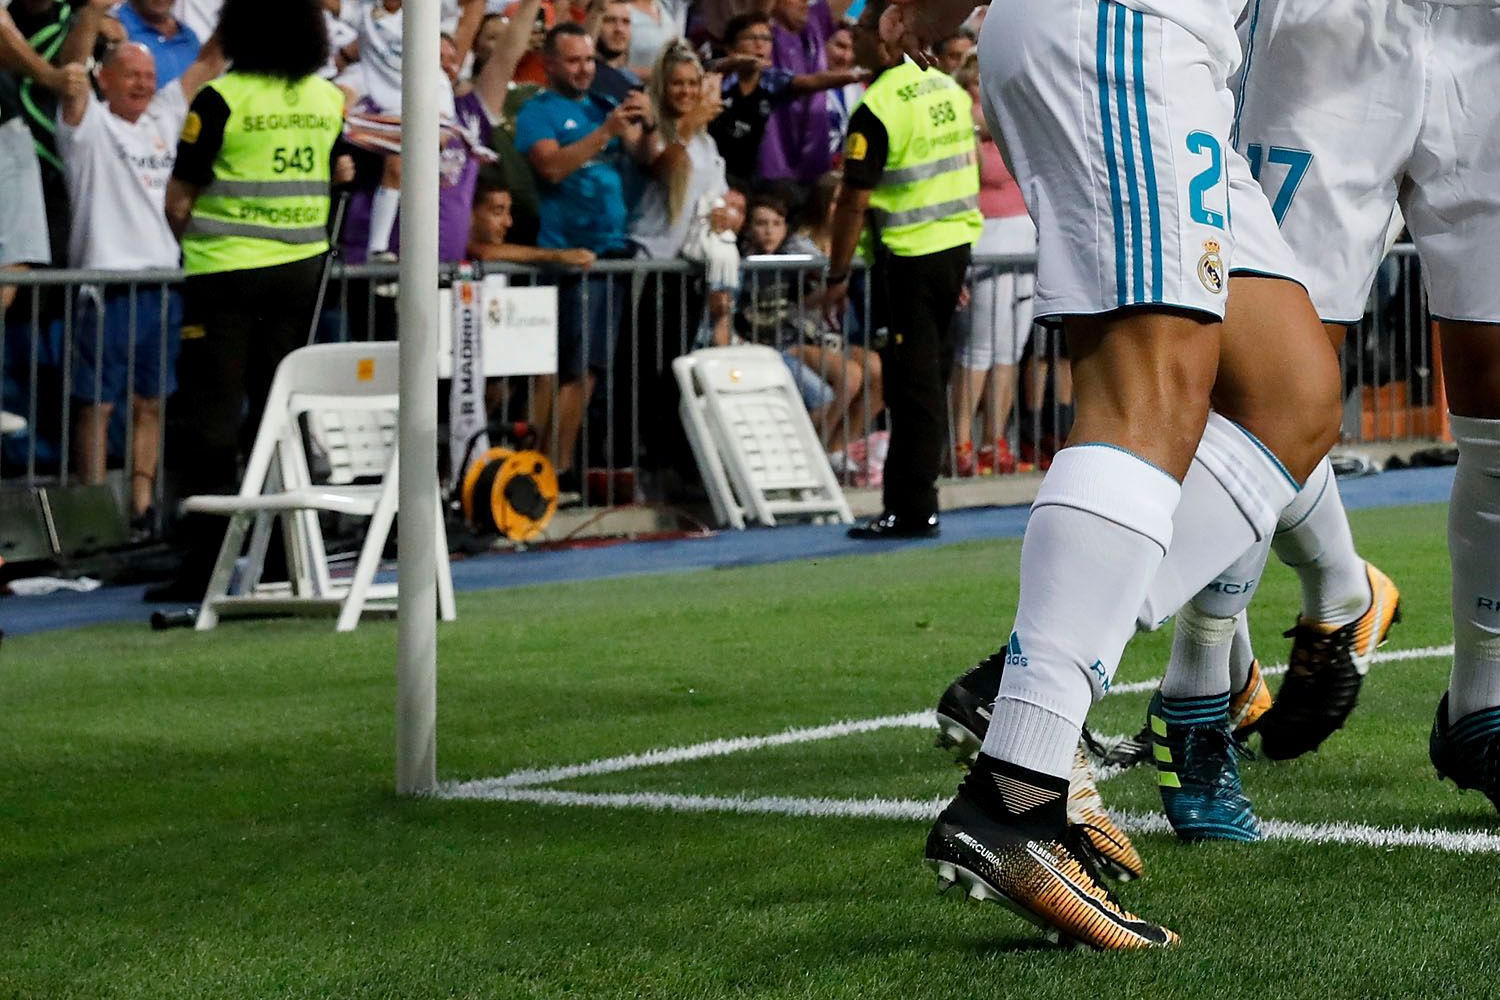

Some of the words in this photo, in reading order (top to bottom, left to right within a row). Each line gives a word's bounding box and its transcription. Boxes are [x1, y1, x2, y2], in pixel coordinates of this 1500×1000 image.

[272, 146, 315, 174] 543
[460, 308, 474, 395] MADRID
[1206, 578, 1256, 596] MCF
